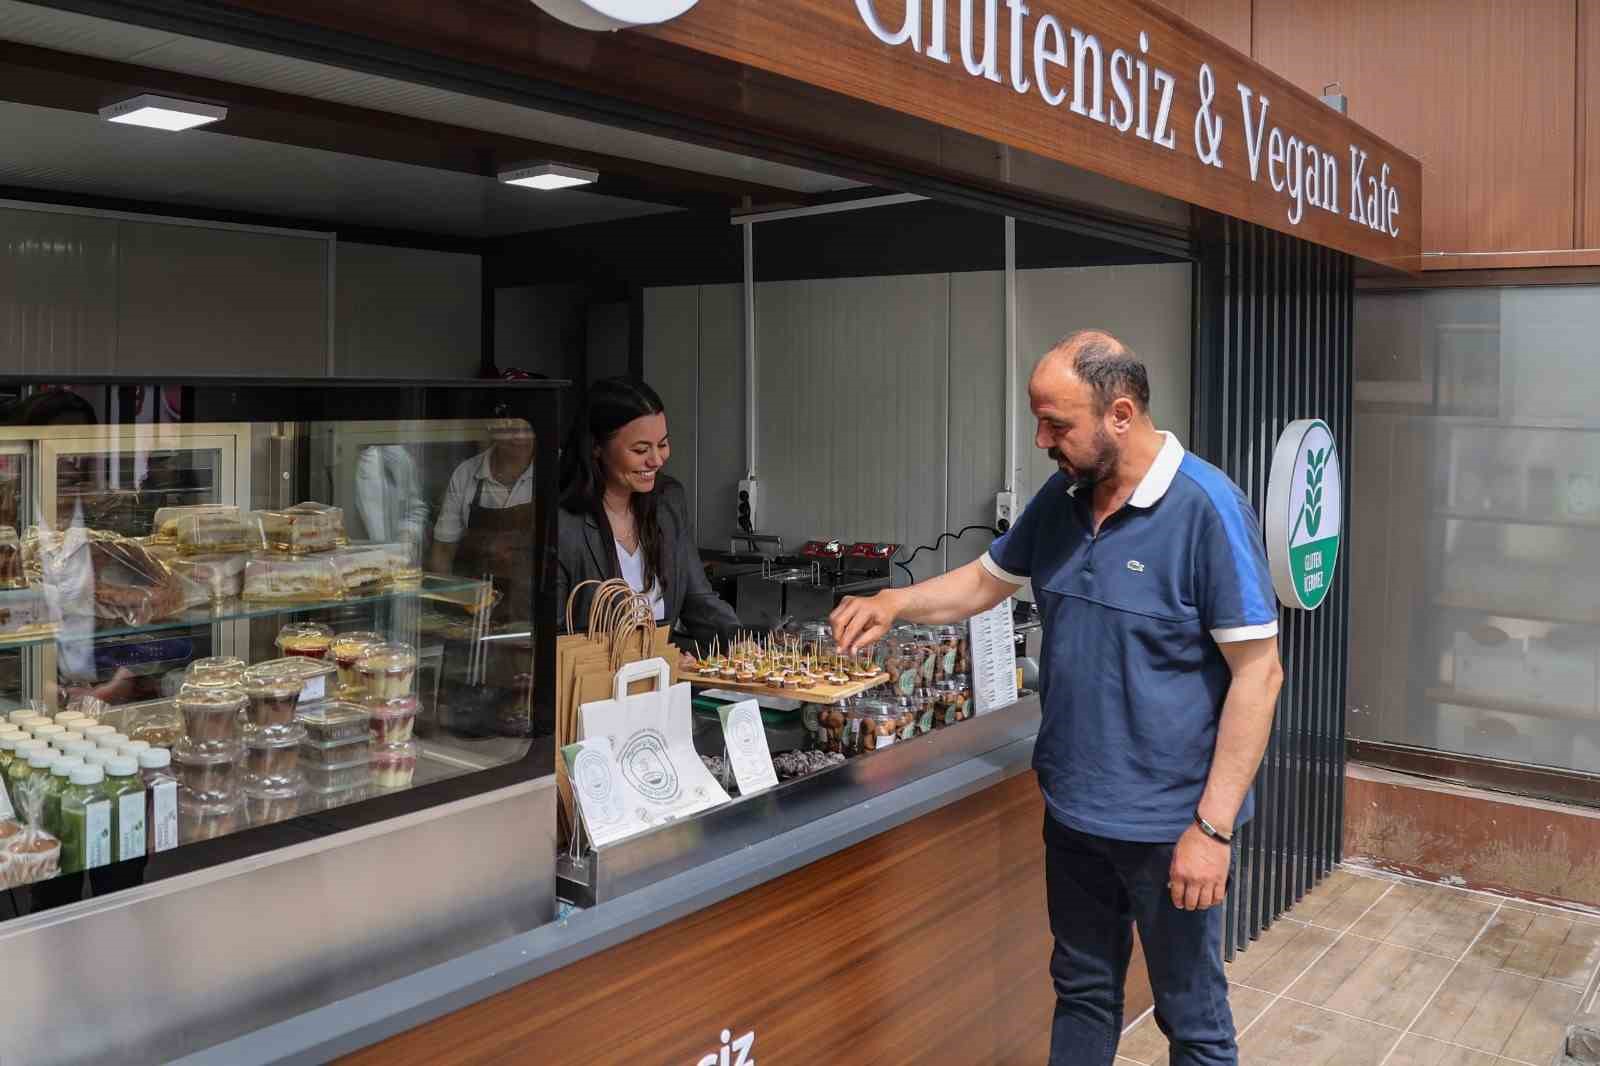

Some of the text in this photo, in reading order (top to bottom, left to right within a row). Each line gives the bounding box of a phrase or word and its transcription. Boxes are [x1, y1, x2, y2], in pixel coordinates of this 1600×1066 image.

[855, 0, 1400, 238] utensiz & Vegan Kafe
[1304, 551, 1322, 571] GLUTEN
